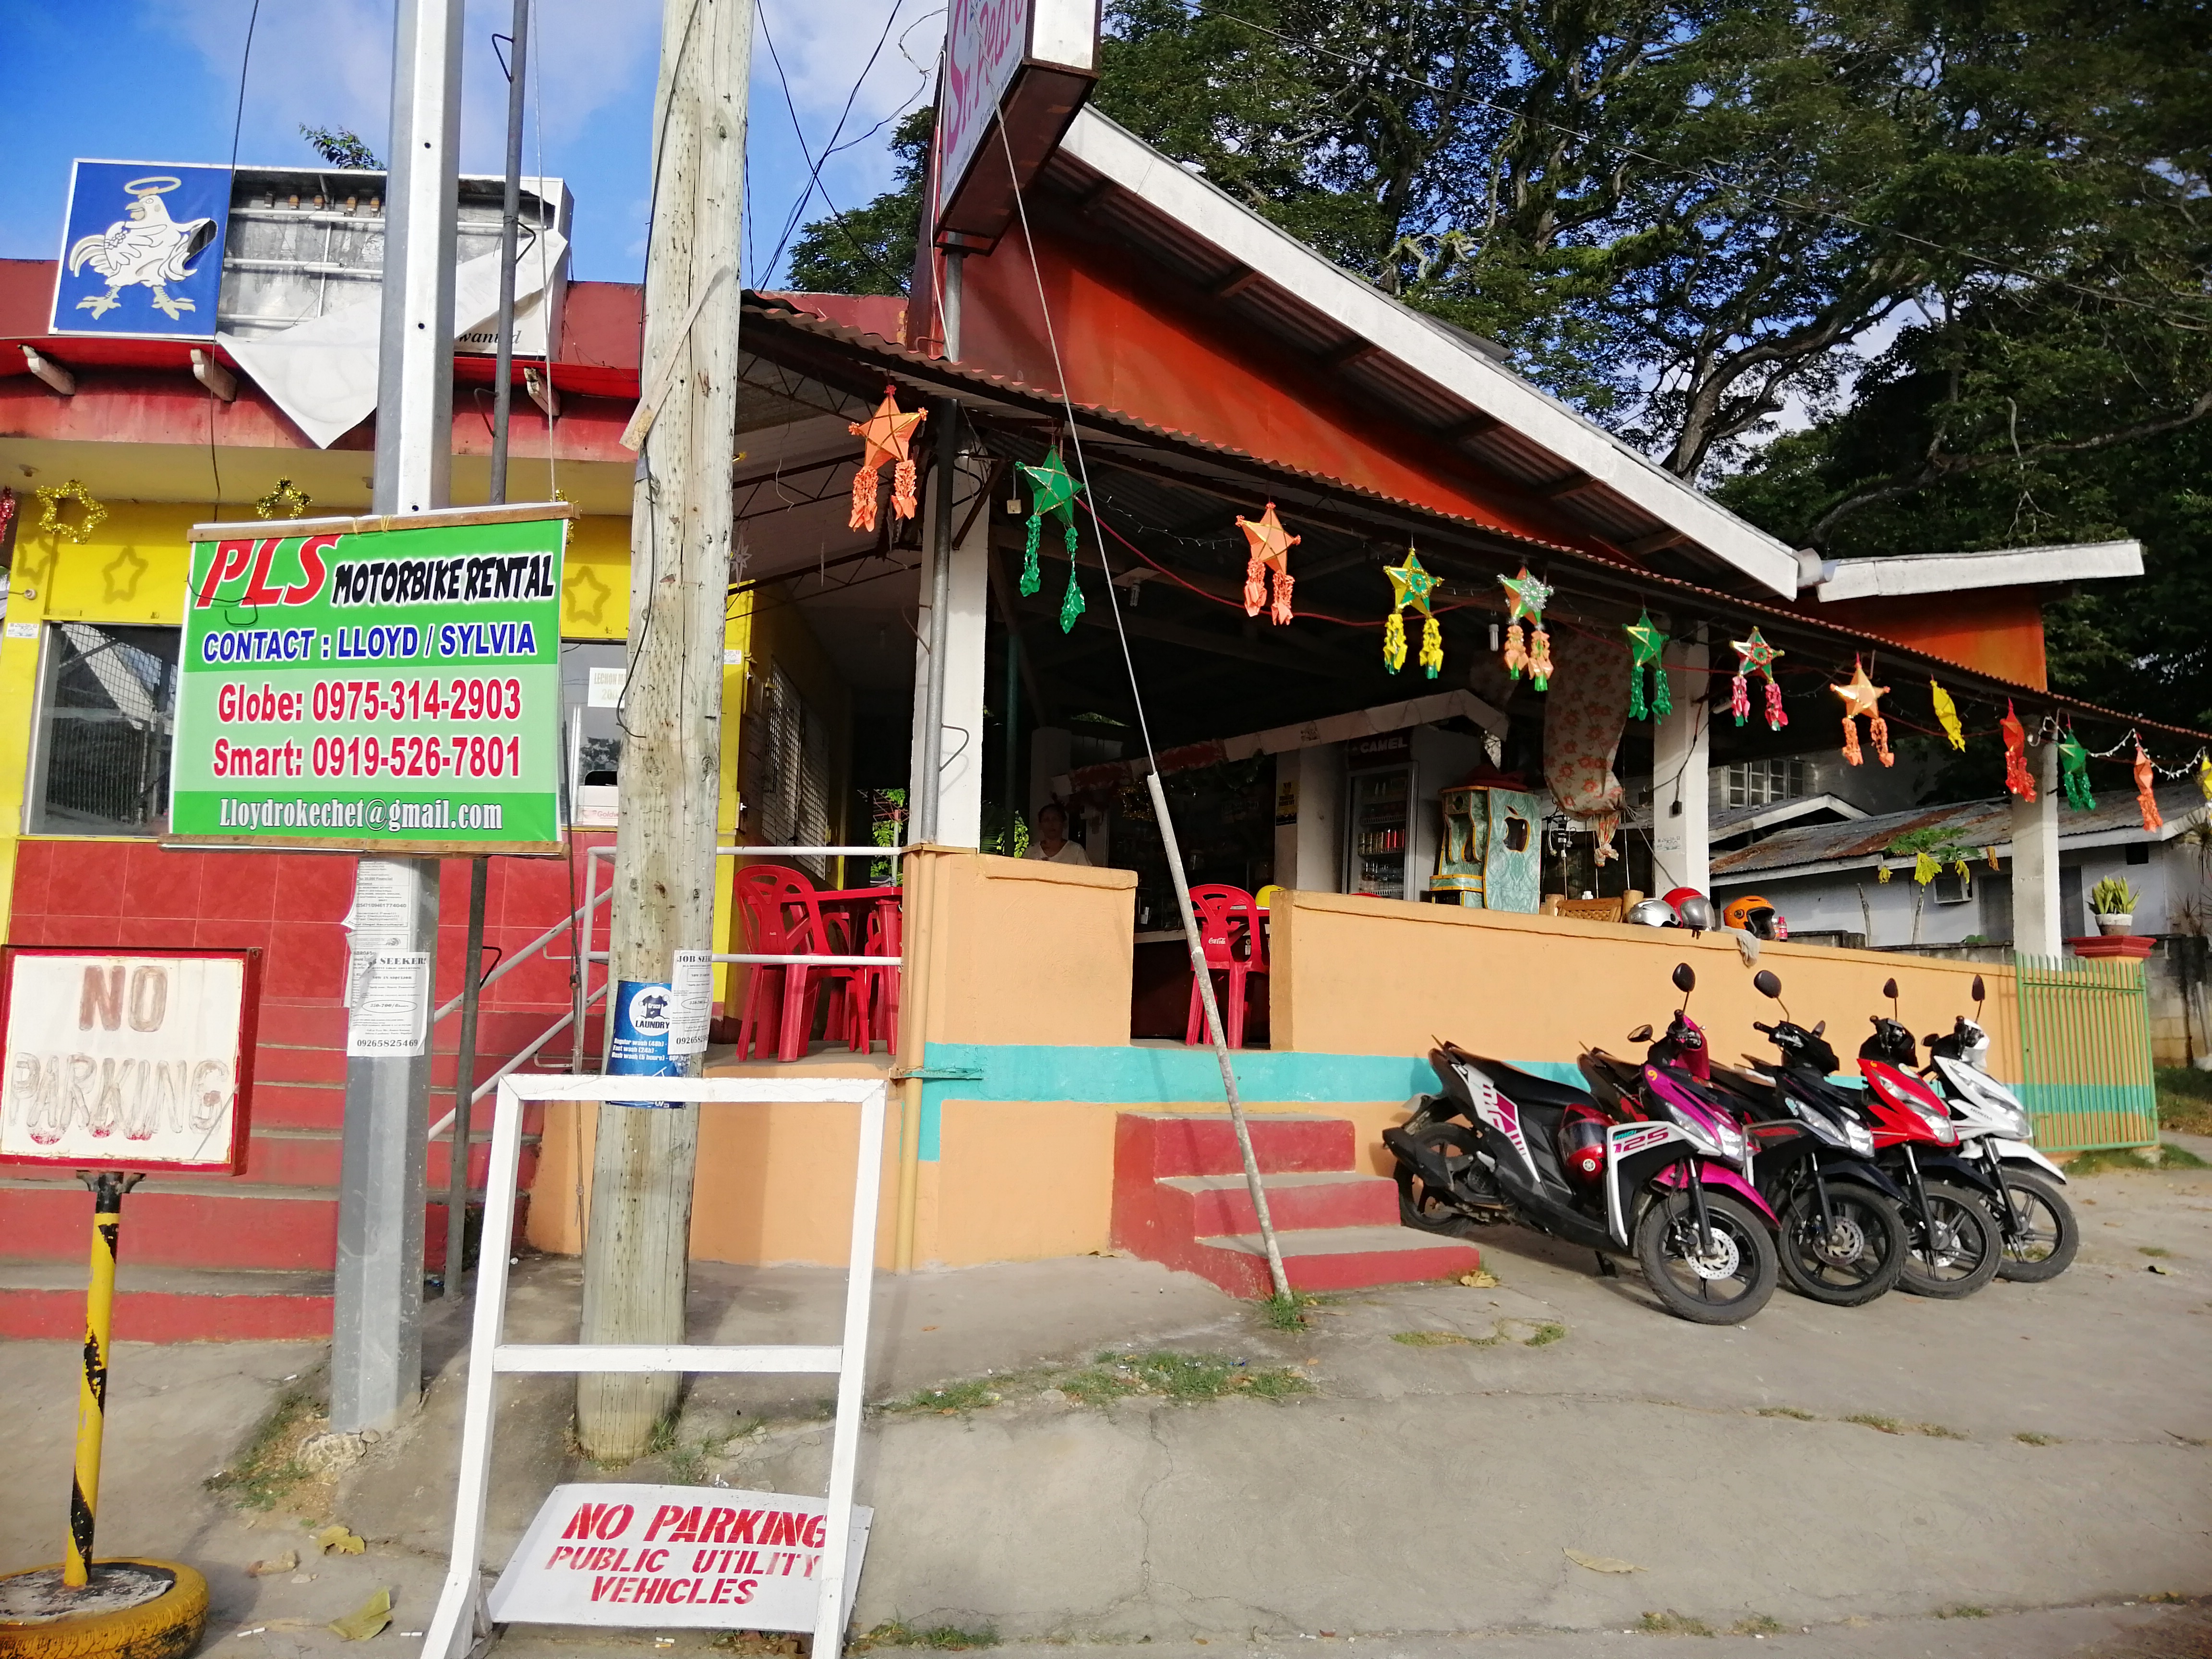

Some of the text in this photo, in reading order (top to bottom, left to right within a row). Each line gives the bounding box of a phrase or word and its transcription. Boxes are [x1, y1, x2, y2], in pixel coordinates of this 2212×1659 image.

[195, 534, 555, 610] PLS MOTORBIKE RENTAL
[204, 629, 315, 661] CONTACT
[337, 626, 418, 659] LLOYD
[424, 625, 434, 658] /
[440, 623, 537, 657] SYLVIA
[218, 679, 522, 723] Globe: 0975-314-2903
[214, 735, 520, 778] Smart: 0919-526-7801
[1360, 737, 1408, 753] CAMEL
[219, 797, 503, 832] Lloydrokechet@gmail.com
[79, 964, 168, 1032] NO
[635, 1020, 670, 1029] LAUNDRY
[1613, 1127, 1669, 1154] 125
[561, 1502, 828, 1548] NO PARKING
[544, 1546, 823, 1578] PUBLIC UTILITY
[590, 1575, 759, 1605] VEHICLES
